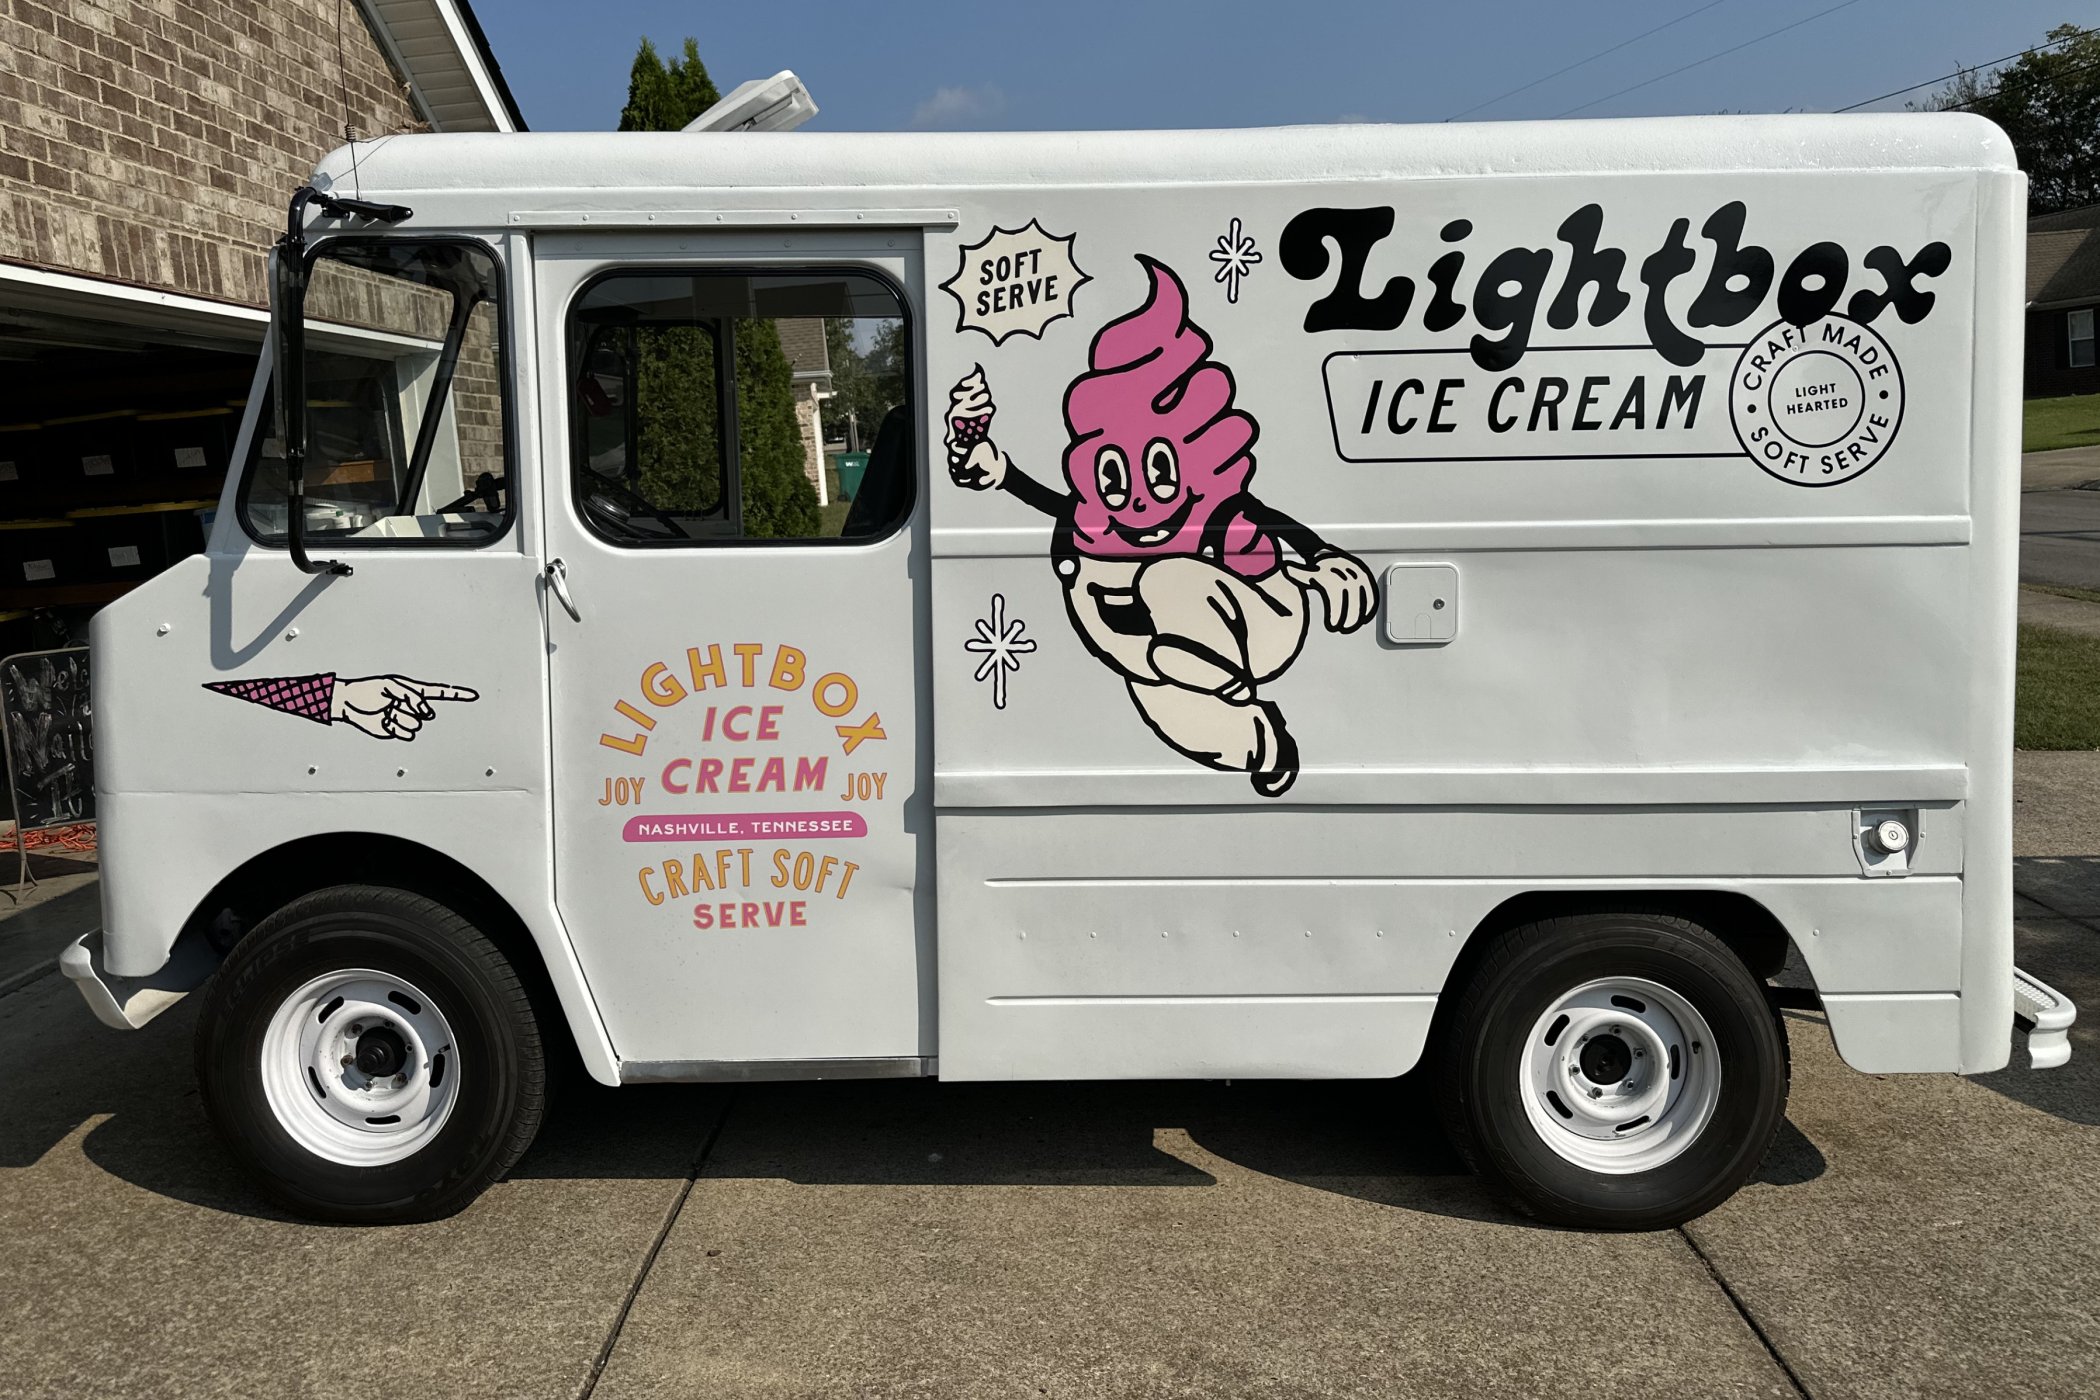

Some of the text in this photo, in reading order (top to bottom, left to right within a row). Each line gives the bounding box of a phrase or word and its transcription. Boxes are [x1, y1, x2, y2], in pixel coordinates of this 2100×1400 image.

[979, 248, 1042, 286] SOFT
[976, 275, 1059, 317] SERVE
[1279, 201, 1951, 372] Lightbox
[1743, 323, 1889, 391] CRAFT MADE
[1361, 374, 1705, 434] ICE CREAM
[1787, 398, 1848, 414] HEARTED
[1795, 383, 1836, 397] LIGHT
[1751, 413, 1889, 474] SOFT SERVE
[599, 643, 888, 756] LIGHTBOX
[702, 705, 784, 742] ICE
[598, 777, 645, 806] JOY
[661, 756, 829, 794] CREAM
[841, 772, 888, 801] JOY
[638, 820, 853, 836] NASHVILLE, TENNESSEE
[638, 848, 860, 906] CRAFT SOFT
[693, 901, 807, 930] SERVE
